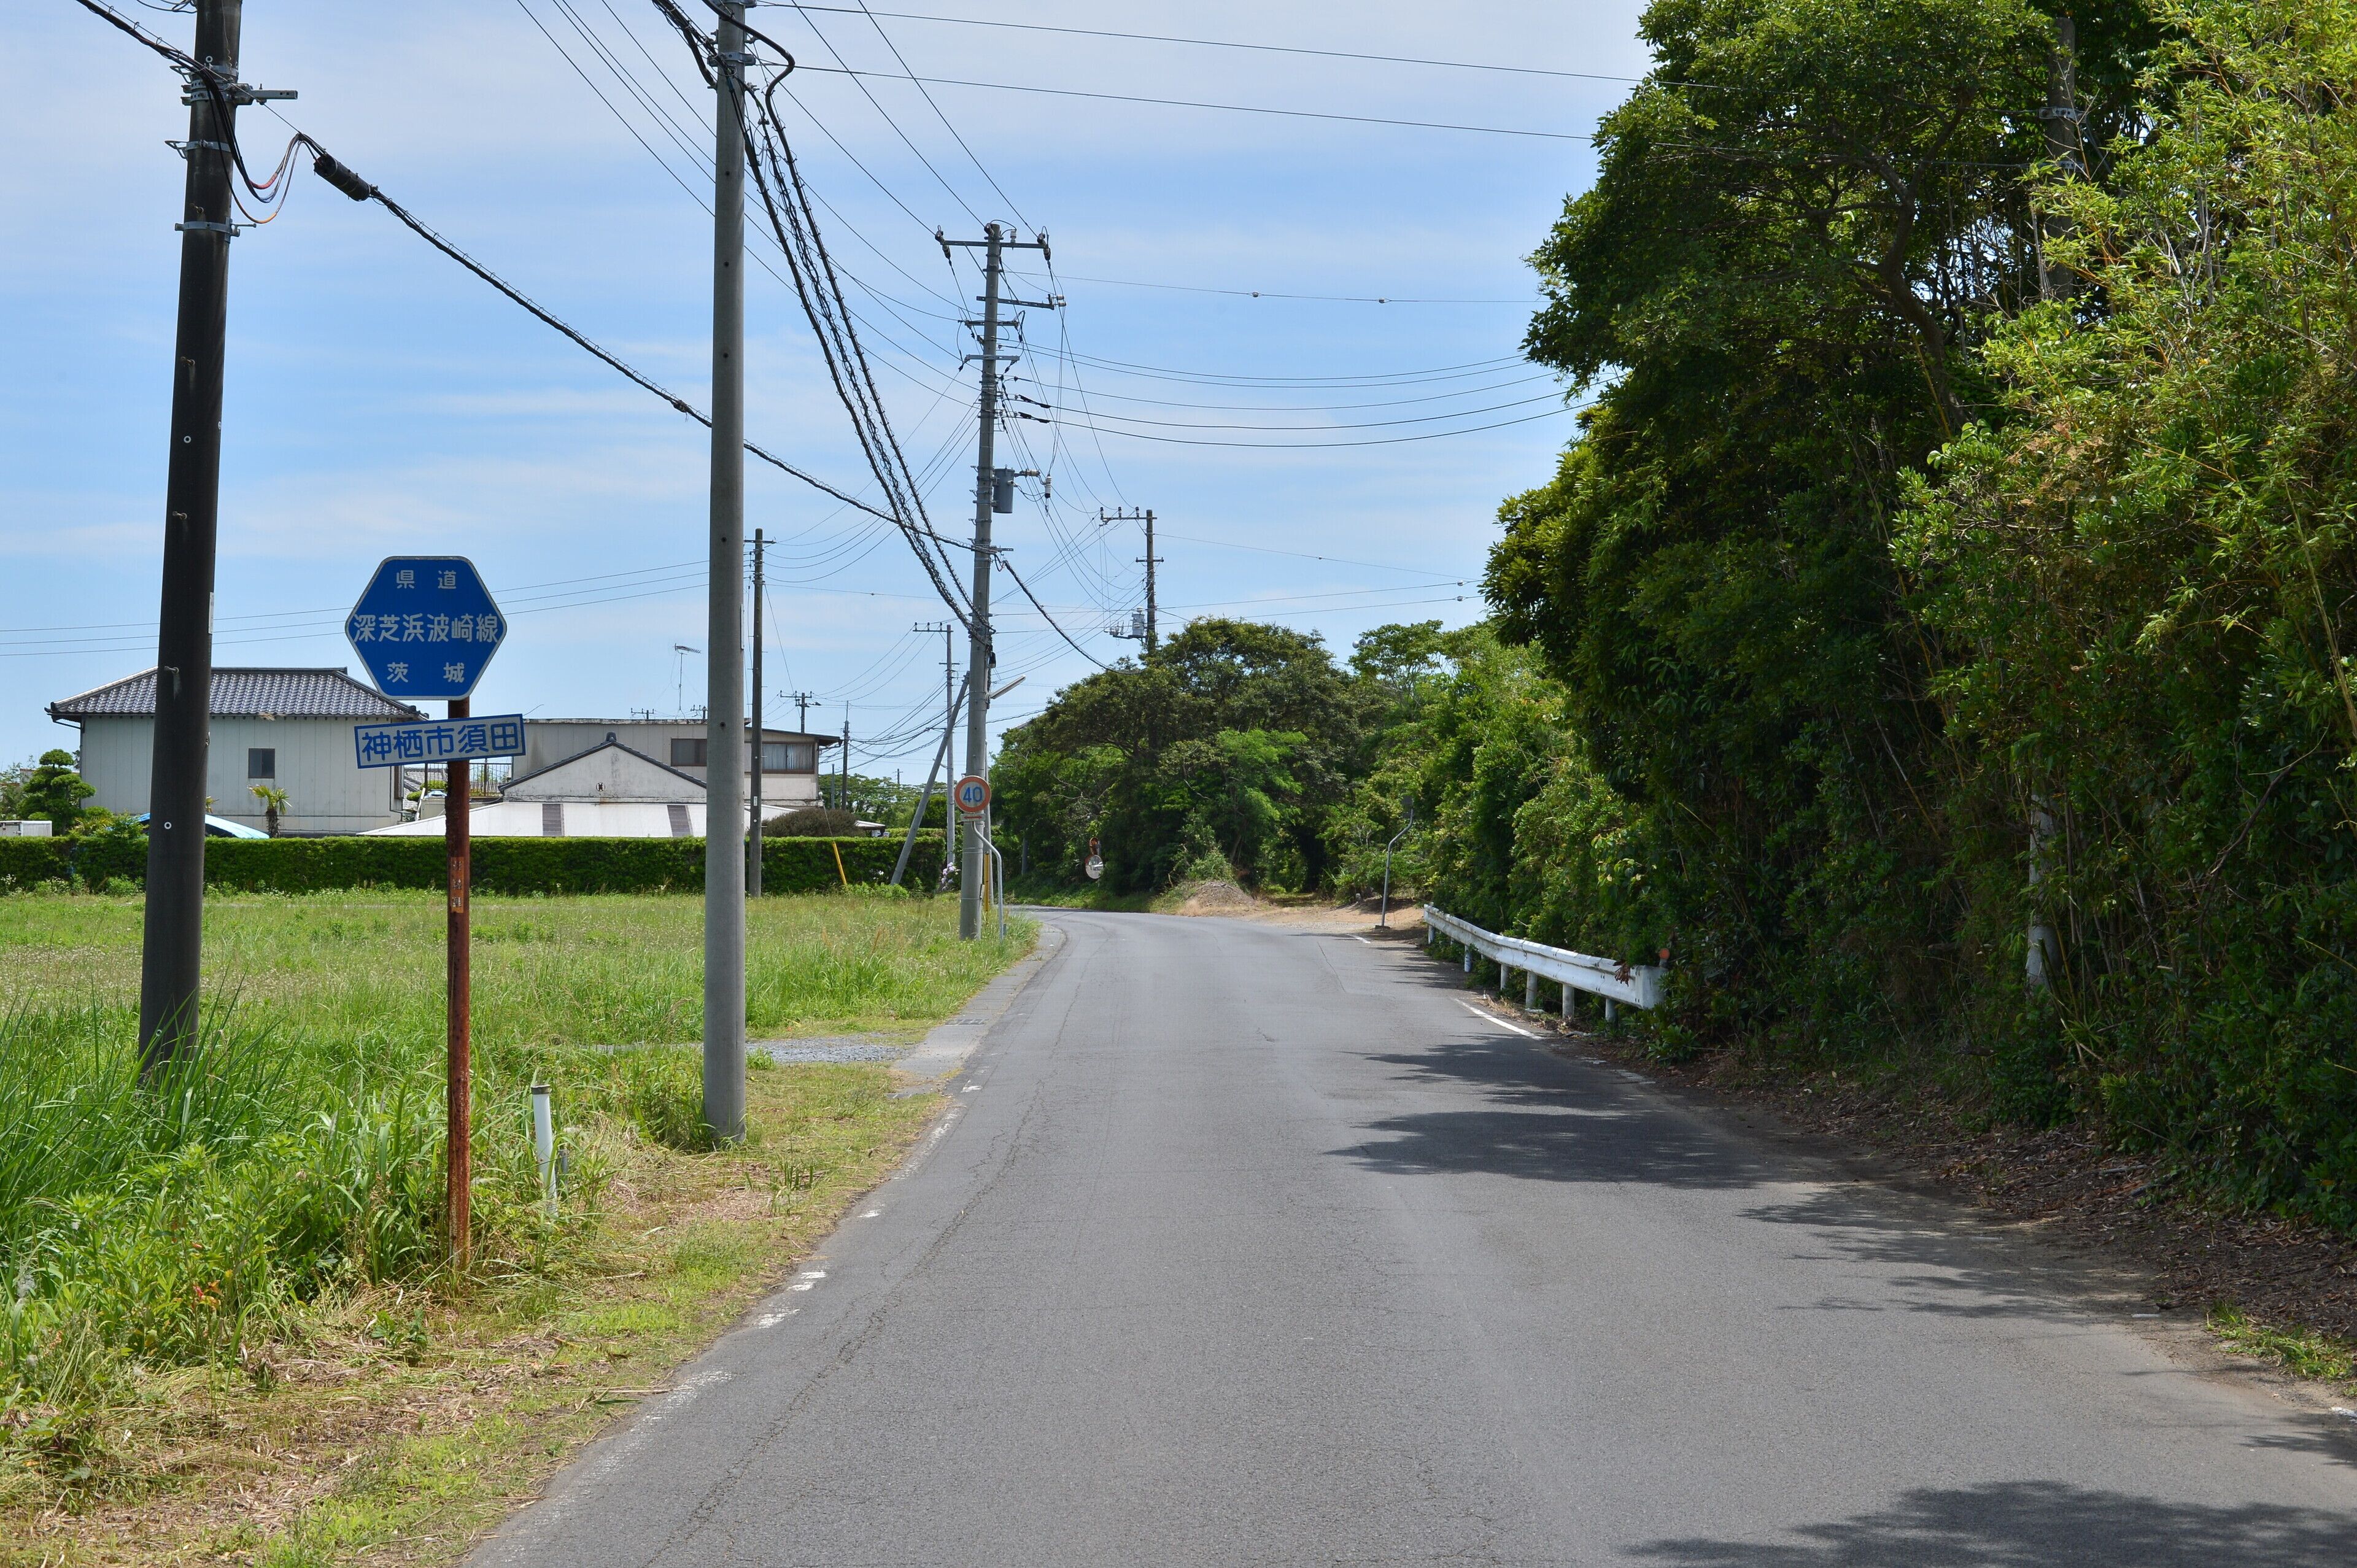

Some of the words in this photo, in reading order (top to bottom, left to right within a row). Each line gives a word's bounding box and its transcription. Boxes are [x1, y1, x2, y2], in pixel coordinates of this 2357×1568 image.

[397, 570, 456, 589] 県道
[354, 613, 498, 643] 深芝浜波崎線
[387, 662, 465, 683] 茨城
[362, 722, 518, 761] 神栖市須田
[963, 787, 983, 802] 40
